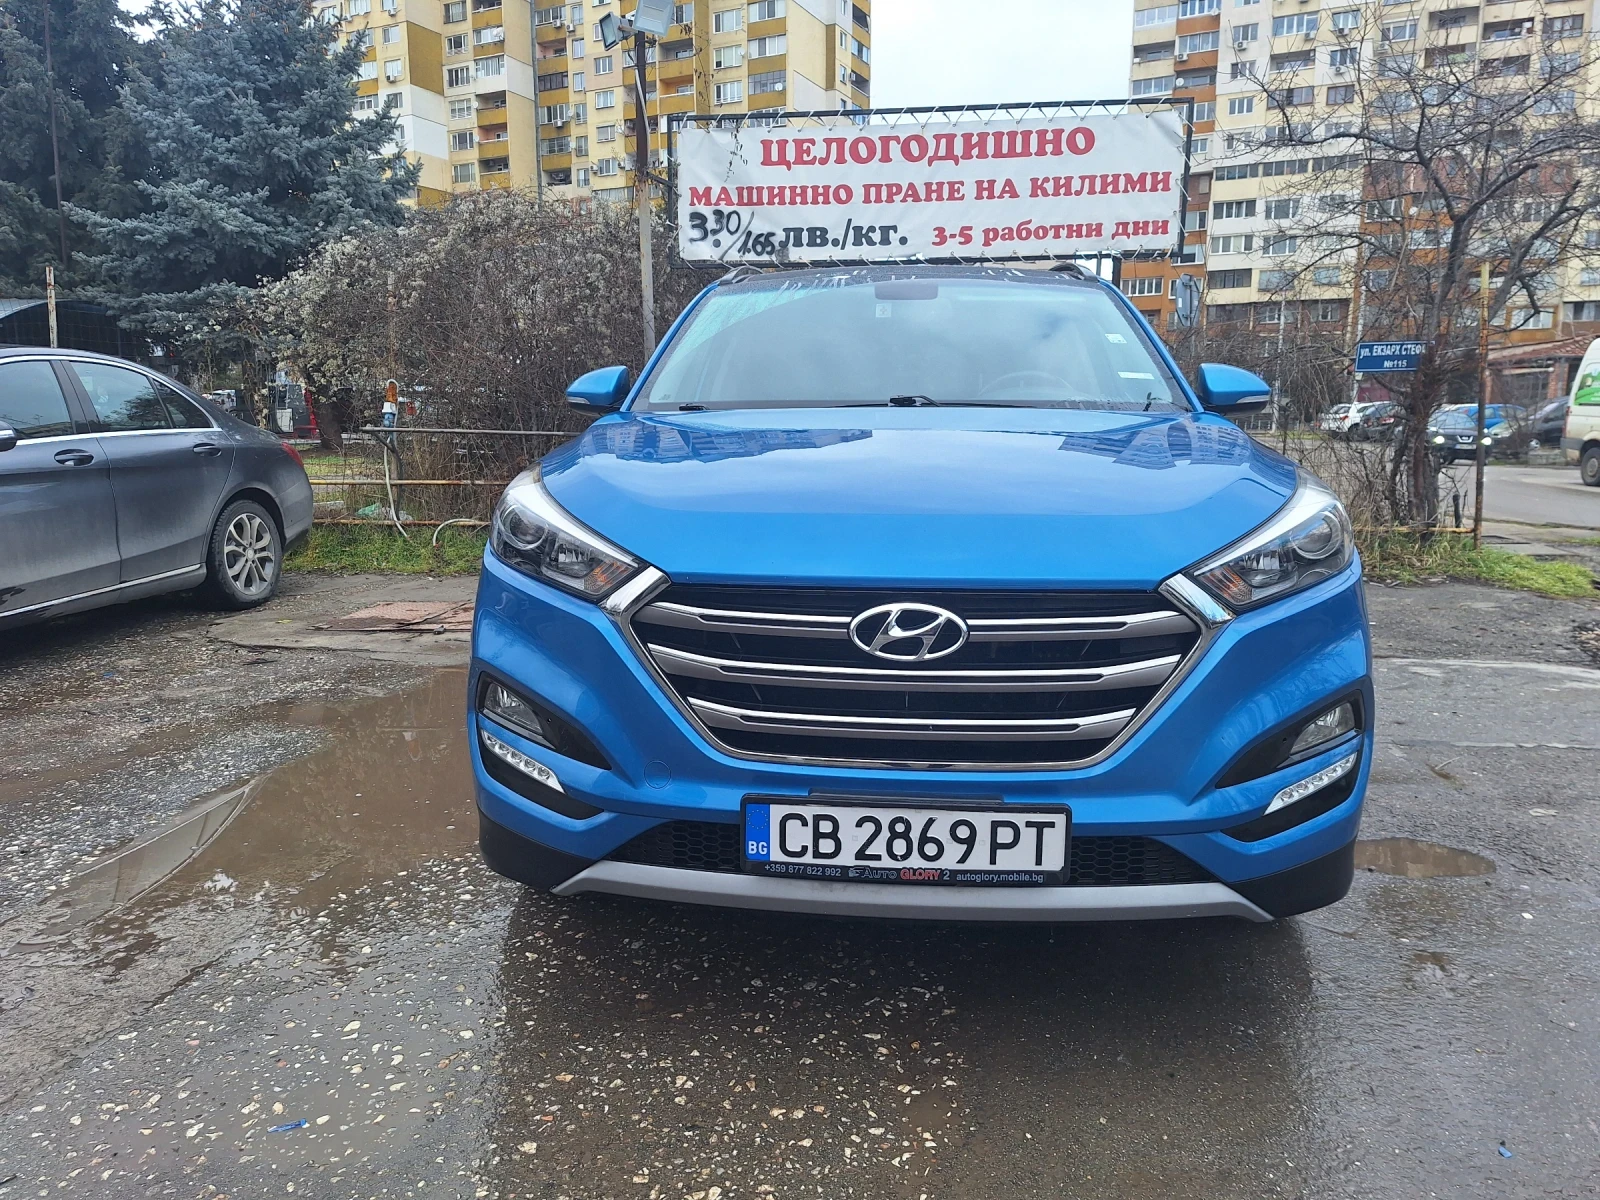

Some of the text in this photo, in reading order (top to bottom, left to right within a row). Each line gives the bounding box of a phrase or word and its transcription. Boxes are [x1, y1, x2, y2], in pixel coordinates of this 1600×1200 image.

[759, 126, 1096, 172] ЦЕЛОГОДИШНО
[688, 171, 1172, 207] МАШИННО ПРАНЕ НА КИЛИМИ
[931, 218, 1170, 247] 3-5 работни дни
[1360, 348, 1371, 359] ул.
[1373, 345, 1400, 355] ЕКЗАРХ
[1383, 360, 1407, 368] №115
[748, 840, 768, 855] BG
[854, 814, 978, 865] 2869
[764, 863, 786, 873] +359
[788, 865, 805, 874] 877
[806, 866, 823, 875] 822
[824, 868, 842, 877] 992
[900, 868, 941, 881] GLORY
[943, 870, 950, 880] 2
[956, 872, 1044, 883] autoglory.mobile.bg
